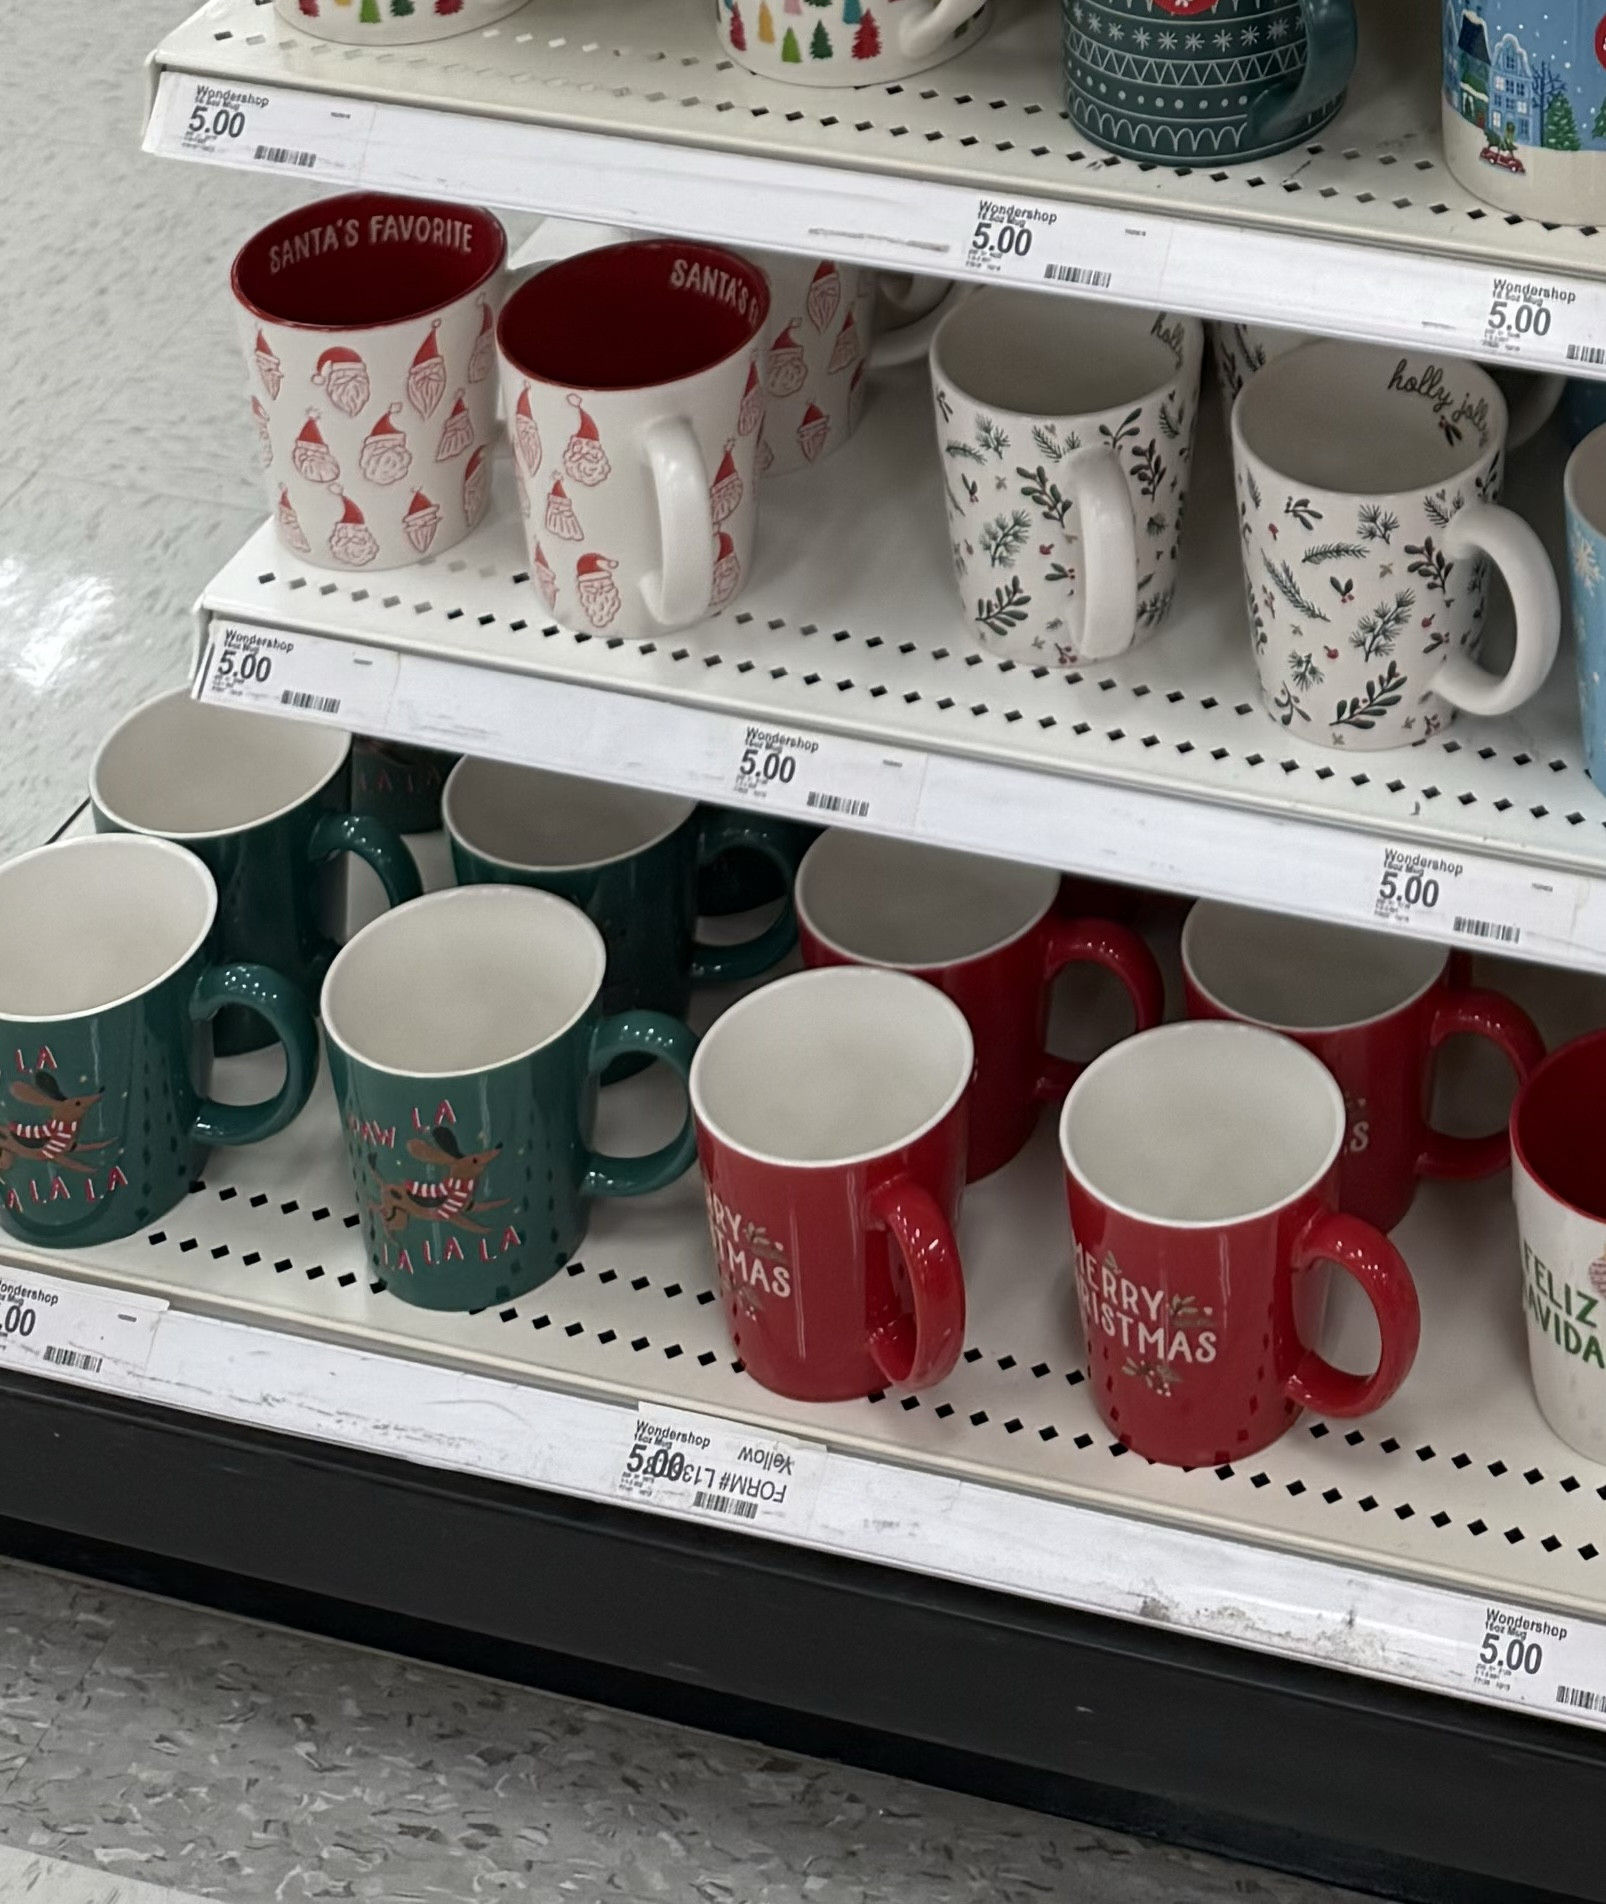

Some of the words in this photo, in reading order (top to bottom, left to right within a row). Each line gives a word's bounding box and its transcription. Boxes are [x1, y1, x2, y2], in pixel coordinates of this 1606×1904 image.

[189, 105, 245, 138] 5.00
[979, 200, 1058, 225] Wondershop
[269, 218, 360, 274] SANTA'S
[369, 214, 473, 253] FAVORITE
[972, 222, 1032, 256] 5.00
[670, 258, 748, 315] SANTA'S
[1494, 278, 1576, 304] Wondershop
[1488, 301, 1551, 336] 5.00
[1387, 358, 1454, 412] holly
[225, 629, 294, 653] Wondershop
[218, 650, 271, 683] 5.00
[746, 726, 819, 754] Wondershop
[740, 748, 796, 784] 5.00
[1384, 848, 1463, 877] Wondershop
[1379, 871, 1439, 907] 5.00
[16, 1046, 58, 1073] LA
[410, 1099, 457, 1131] LA
[31, 1177, 71, 1204] LA
[84, 1166, 128, 1201] LA
[423, 1237, 464, 1265] LA
[480, 1226, 521, 1262] LA
[1523, 1239, 1599, 1329] FELIZ
[636, 1420, 711, 1450] Wondershop
[737, 1446, 791, 1476] Yellow
[719, 1472, 787, 1505] FORM#
[1487, 1607, 1568, 1641] Wondershop
[1479, 1632, 1542, 1675] 5.00
